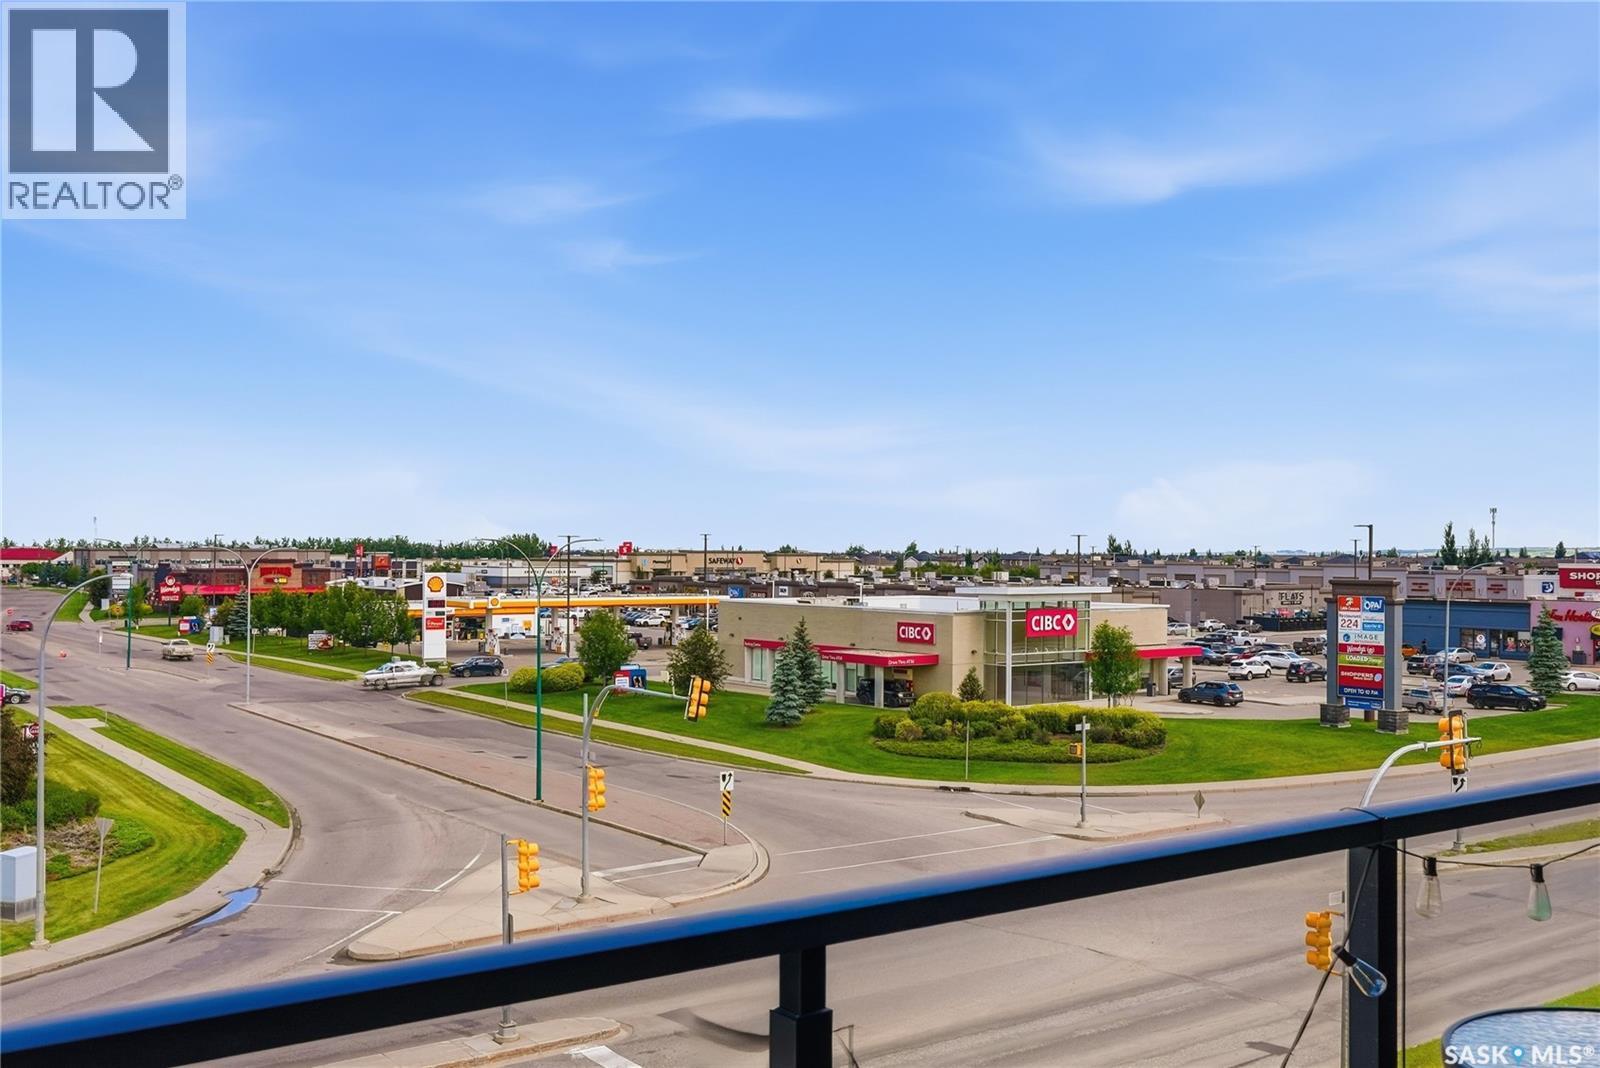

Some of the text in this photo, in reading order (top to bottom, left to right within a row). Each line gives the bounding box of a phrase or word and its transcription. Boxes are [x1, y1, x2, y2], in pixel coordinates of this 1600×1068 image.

[708, 557, 736, 565] SAFEWAY
[1280, 592, 1304, 600] FLATS
[1031, 615, 1061, 632] CIBC
[1340, 619, 1359, 629] 224
[899, 626, 921, 640] CIBC
